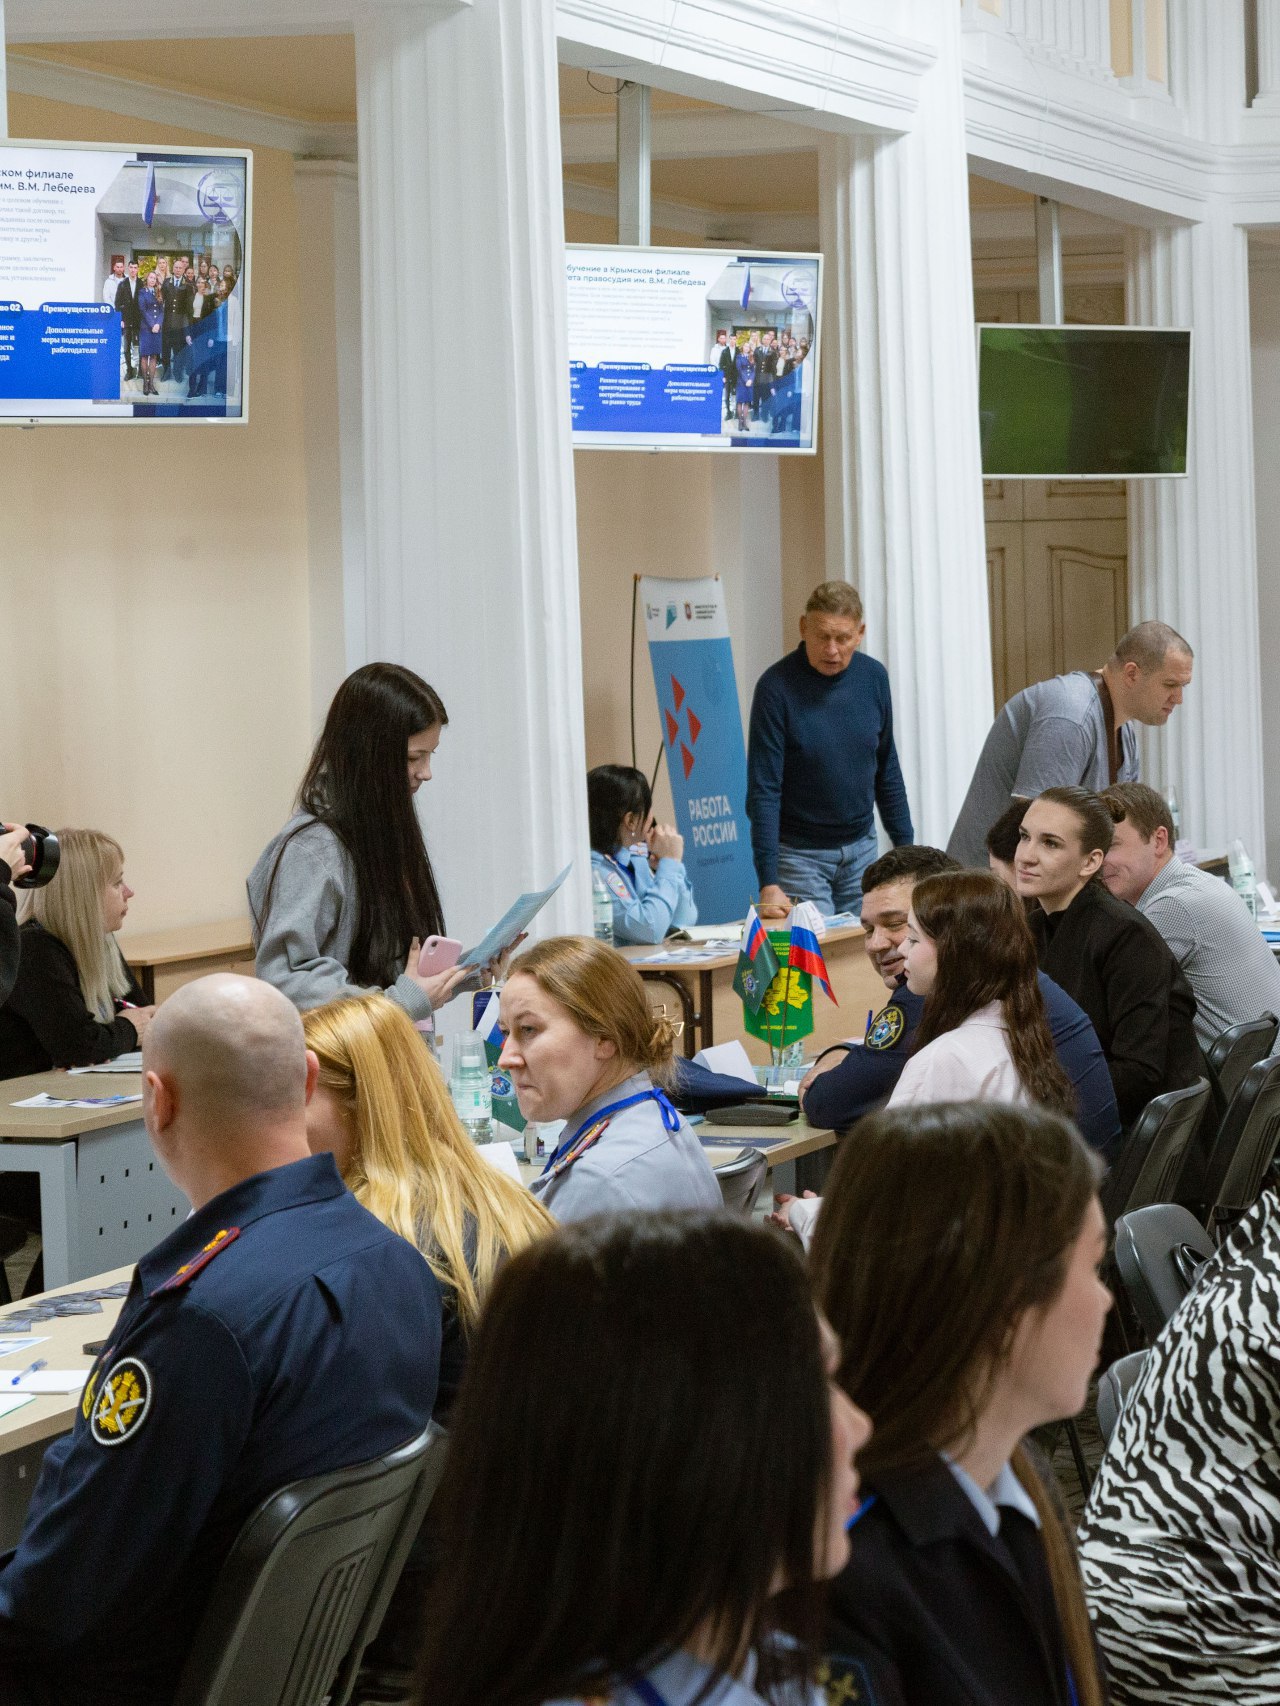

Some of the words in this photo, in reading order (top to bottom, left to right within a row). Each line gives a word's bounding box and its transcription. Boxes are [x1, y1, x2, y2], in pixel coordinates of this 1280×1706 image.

[0, 169, 22, 177] ком
[25, 169, 74, 180] филиале
[18, 182, 40, 192] В.М.
[42, 183, 96, 194] Лебедева
[610, 266, 653, 275] Крымском
[654, 267, 691, 276] филиале
[583, 275, 632, 284] правосудия
[649, 277, 665, 285] В.М.
[667, 278, 706, 287] Лебедева
[9, 303, 21, 312] 02
[42, 304, 99, 314] Преимущество
[100, 305, 111, 314] 03
[45, 326, 104, 335] Дополнительные
[41, 337, 60, 345] меры
[61, 337, 99, 345] поддержки
[51, 346, 98, 355] работодателя
[688, 794, 732, 822] РАБОТА
[692, 820, 738, 848] РОССИИ
